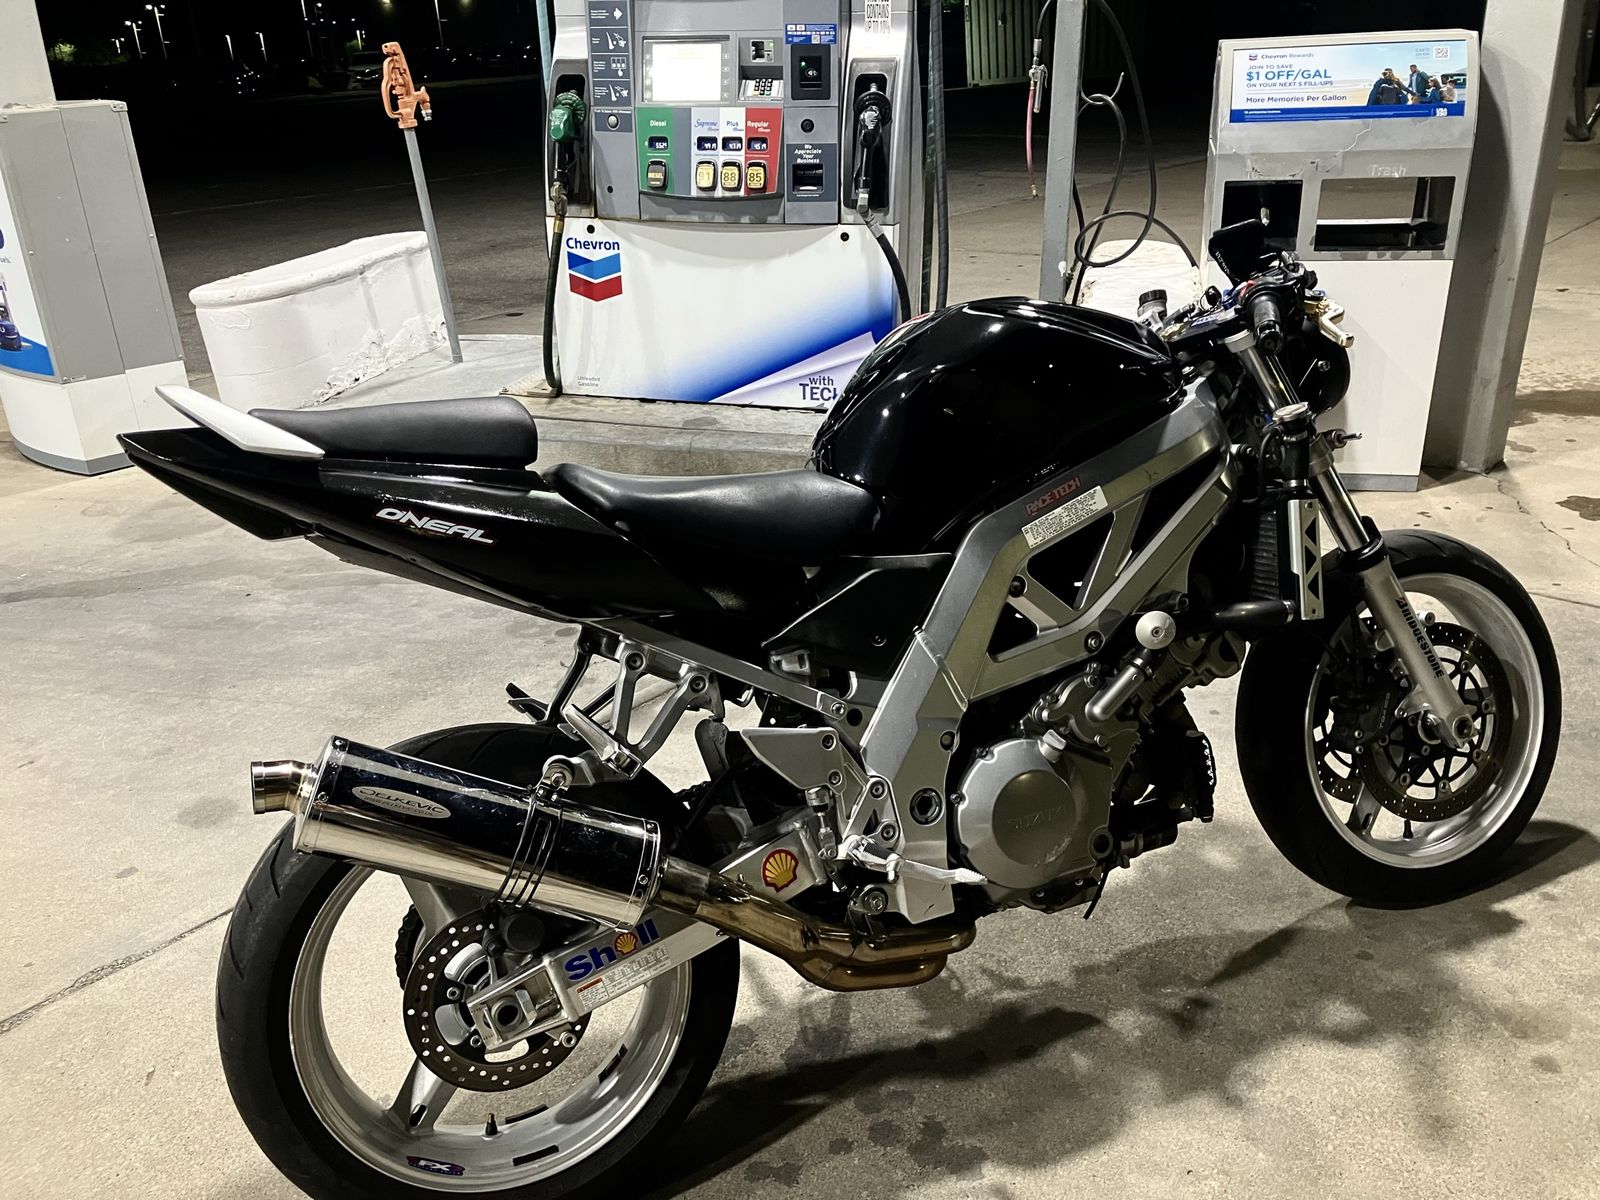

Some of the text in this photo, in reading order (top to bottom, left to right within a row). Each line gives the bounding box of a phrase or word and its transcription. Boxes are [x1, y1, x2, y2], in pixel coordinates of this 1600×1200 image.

[1246, 68, 1332, 82] $1 OFF/GAL
[1246, 96, 1266, 104] More
[1267, 95, 1305, 103] Memories
[1321, 94, 1347, 102] Gallon
[694, 118, 718, 128] Supreme
[747, 120, 769, 129] Regular
[723, 171, 737, 182] 88
[1370, 164, 1407, 178] Trash
[698, 172, 711, 182] 91
[748, 172, 762, 183] 85
[566, 237, 620, 250] Chevron
[809, 376, 834, 386] with
[1395, 597, 1445, 679] BRIDGESTONE
[565, 918, 660, 981] Shll
